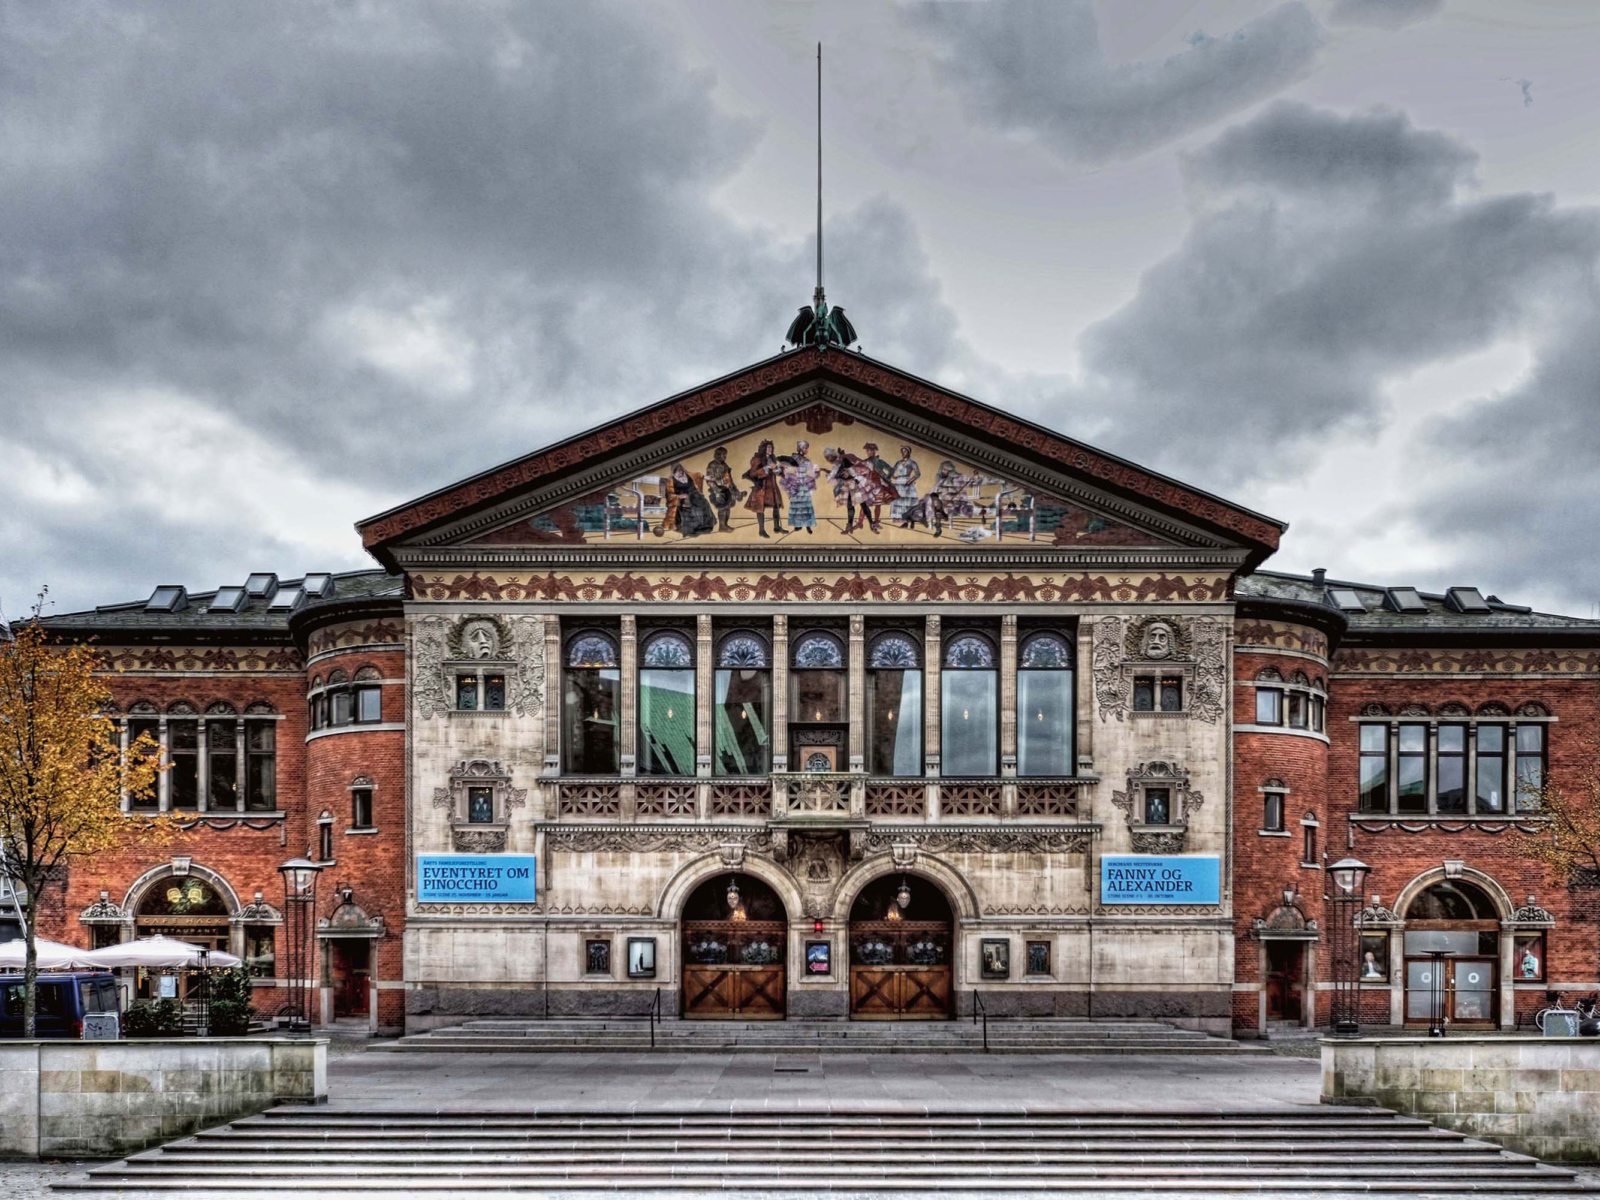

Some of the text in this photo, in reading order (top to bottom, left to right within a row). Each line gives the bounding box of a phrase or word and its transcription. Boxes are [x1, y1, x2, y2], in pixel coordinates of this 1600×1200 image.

[423, 868, 529, 879] EVENTYRET OM
[1107, 869, 1182, 880] FANNY OG
[423, 879, 498, 890] PINOCCHIO
[1107, 881, 1193, 892] ALEXANDER
